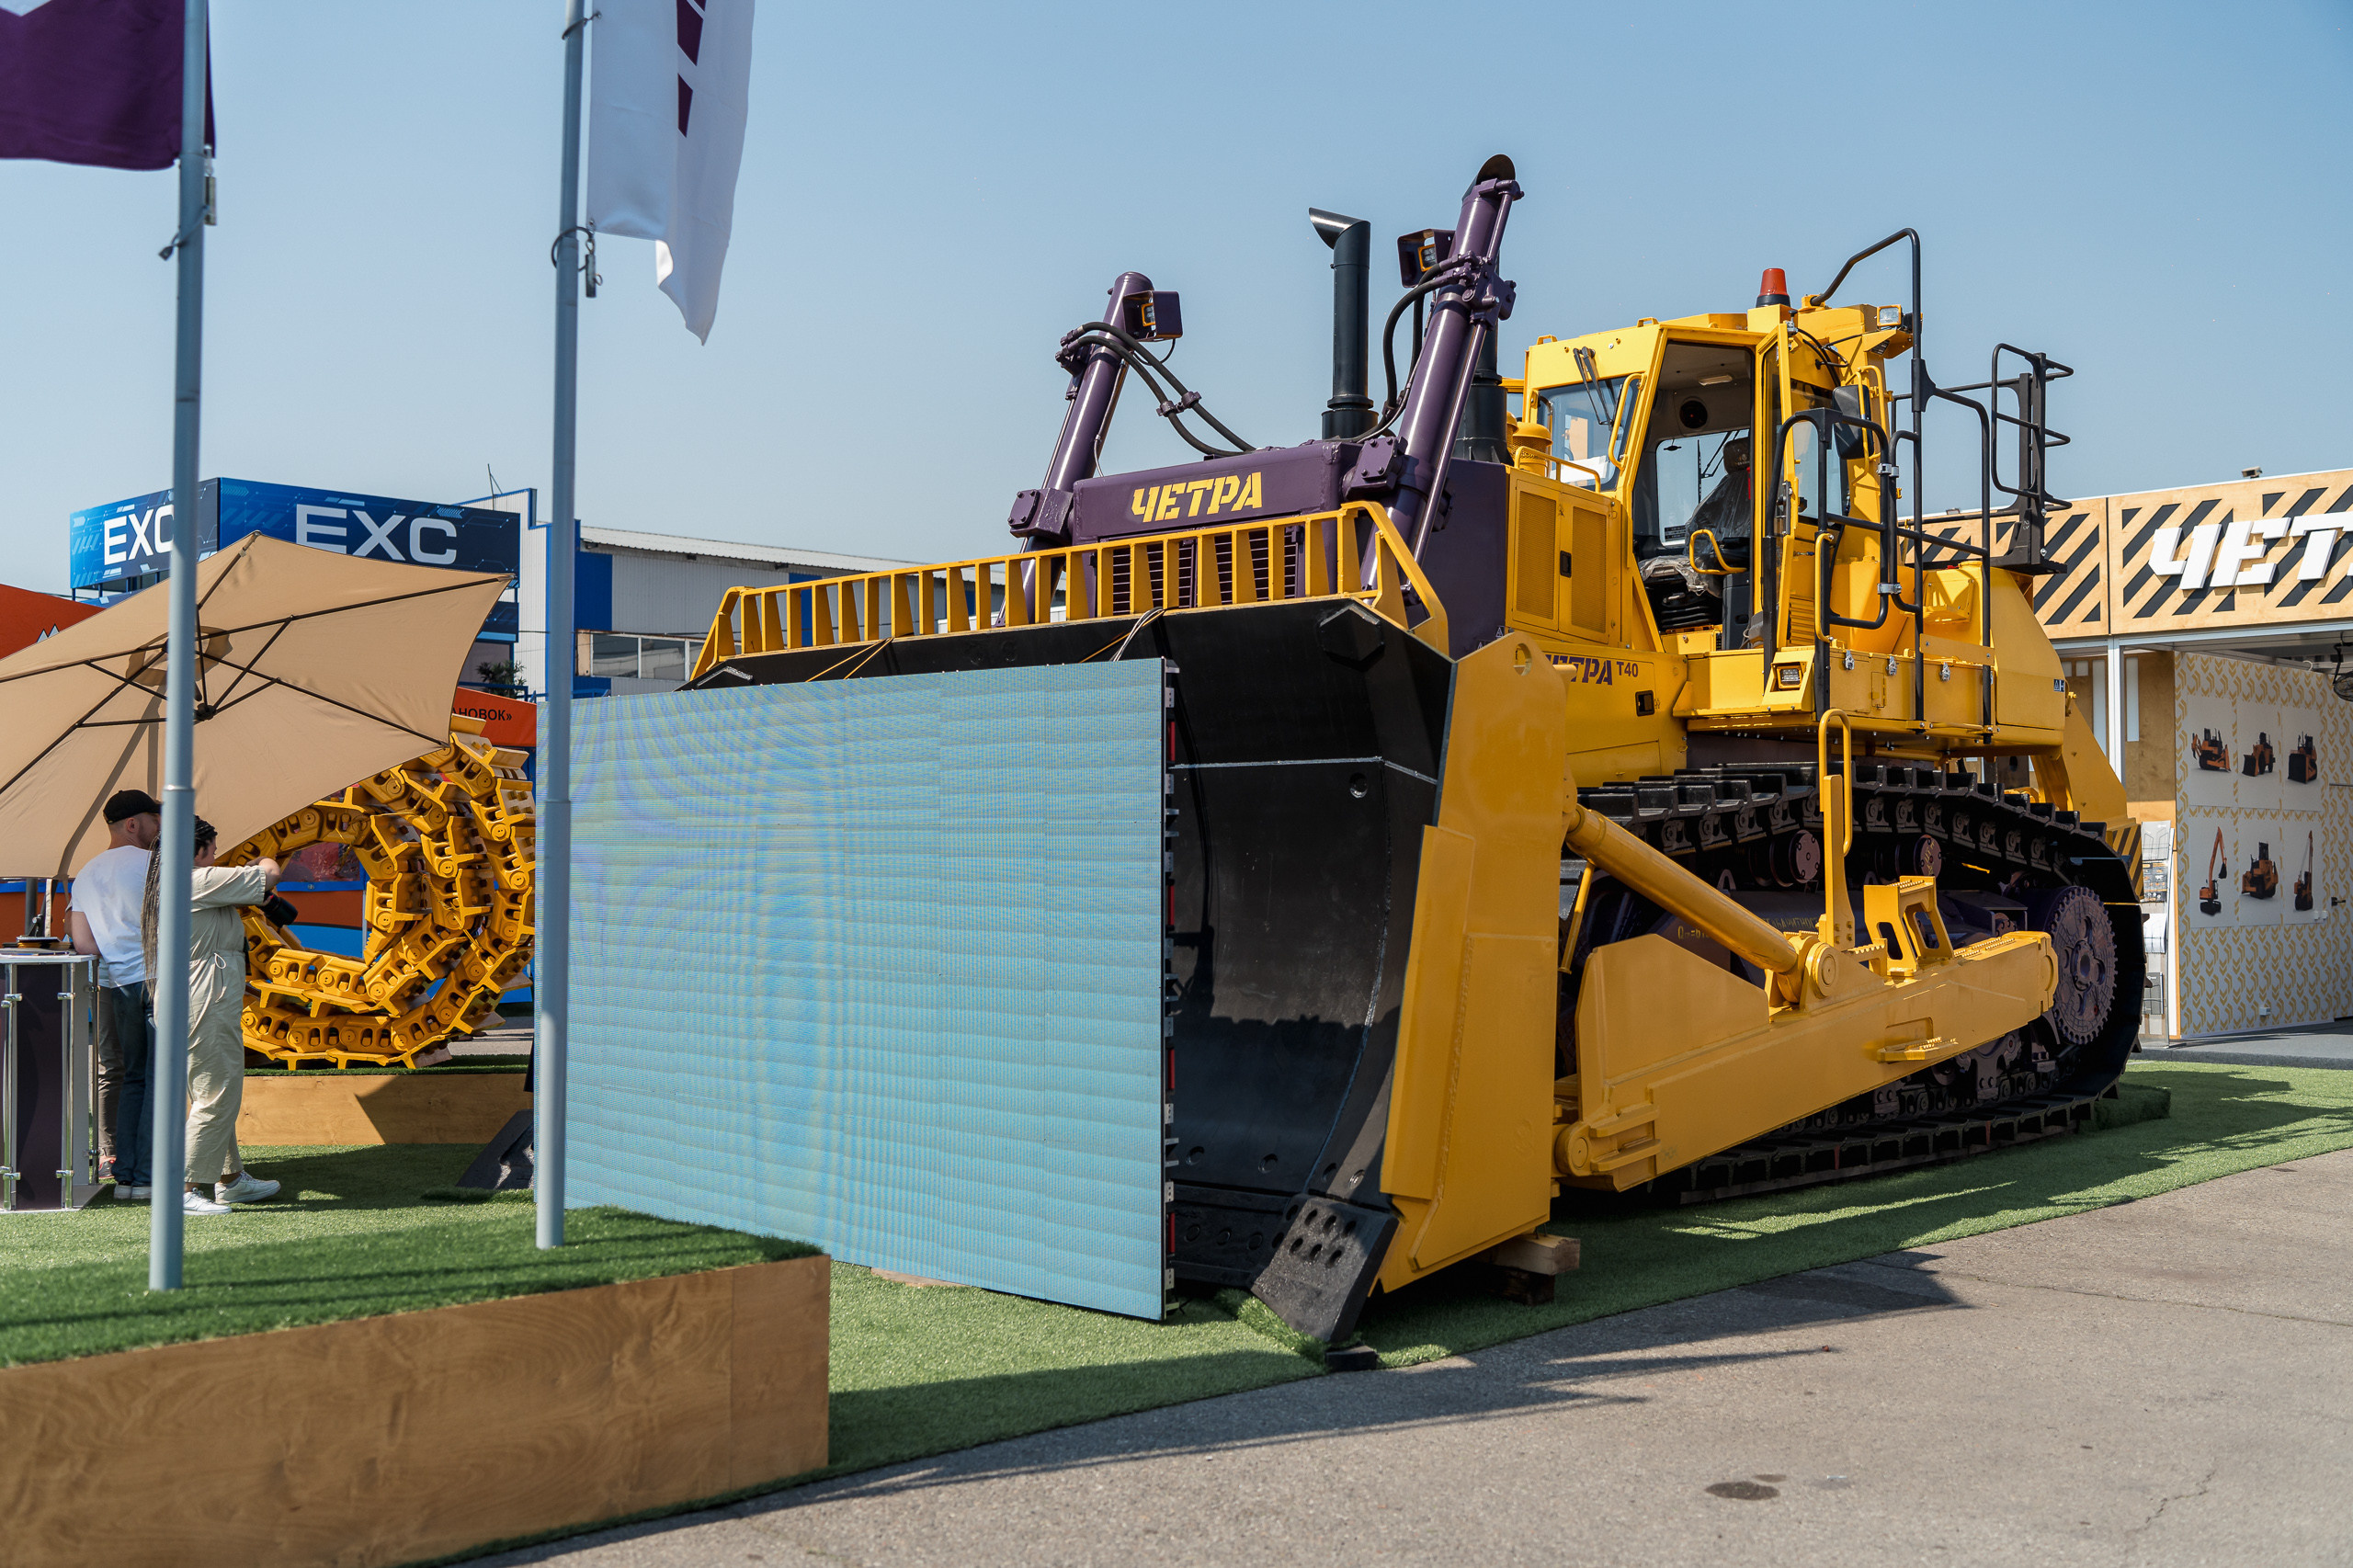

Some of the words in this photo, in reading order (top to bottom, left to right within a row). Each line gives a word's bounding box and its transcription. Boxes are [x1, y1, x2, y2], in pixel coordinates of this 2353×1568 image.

[1131, 472, 1262, 523] ЧЕТРА
[104, 504, 175, 565] EXC
[296, 504, 458, 565] EXC
[2148, 511, 2353, 590] ЧЕТ
[1545, 653, 1613, 686] ТРА
[452, 708, 512, 721] НОВОК»
